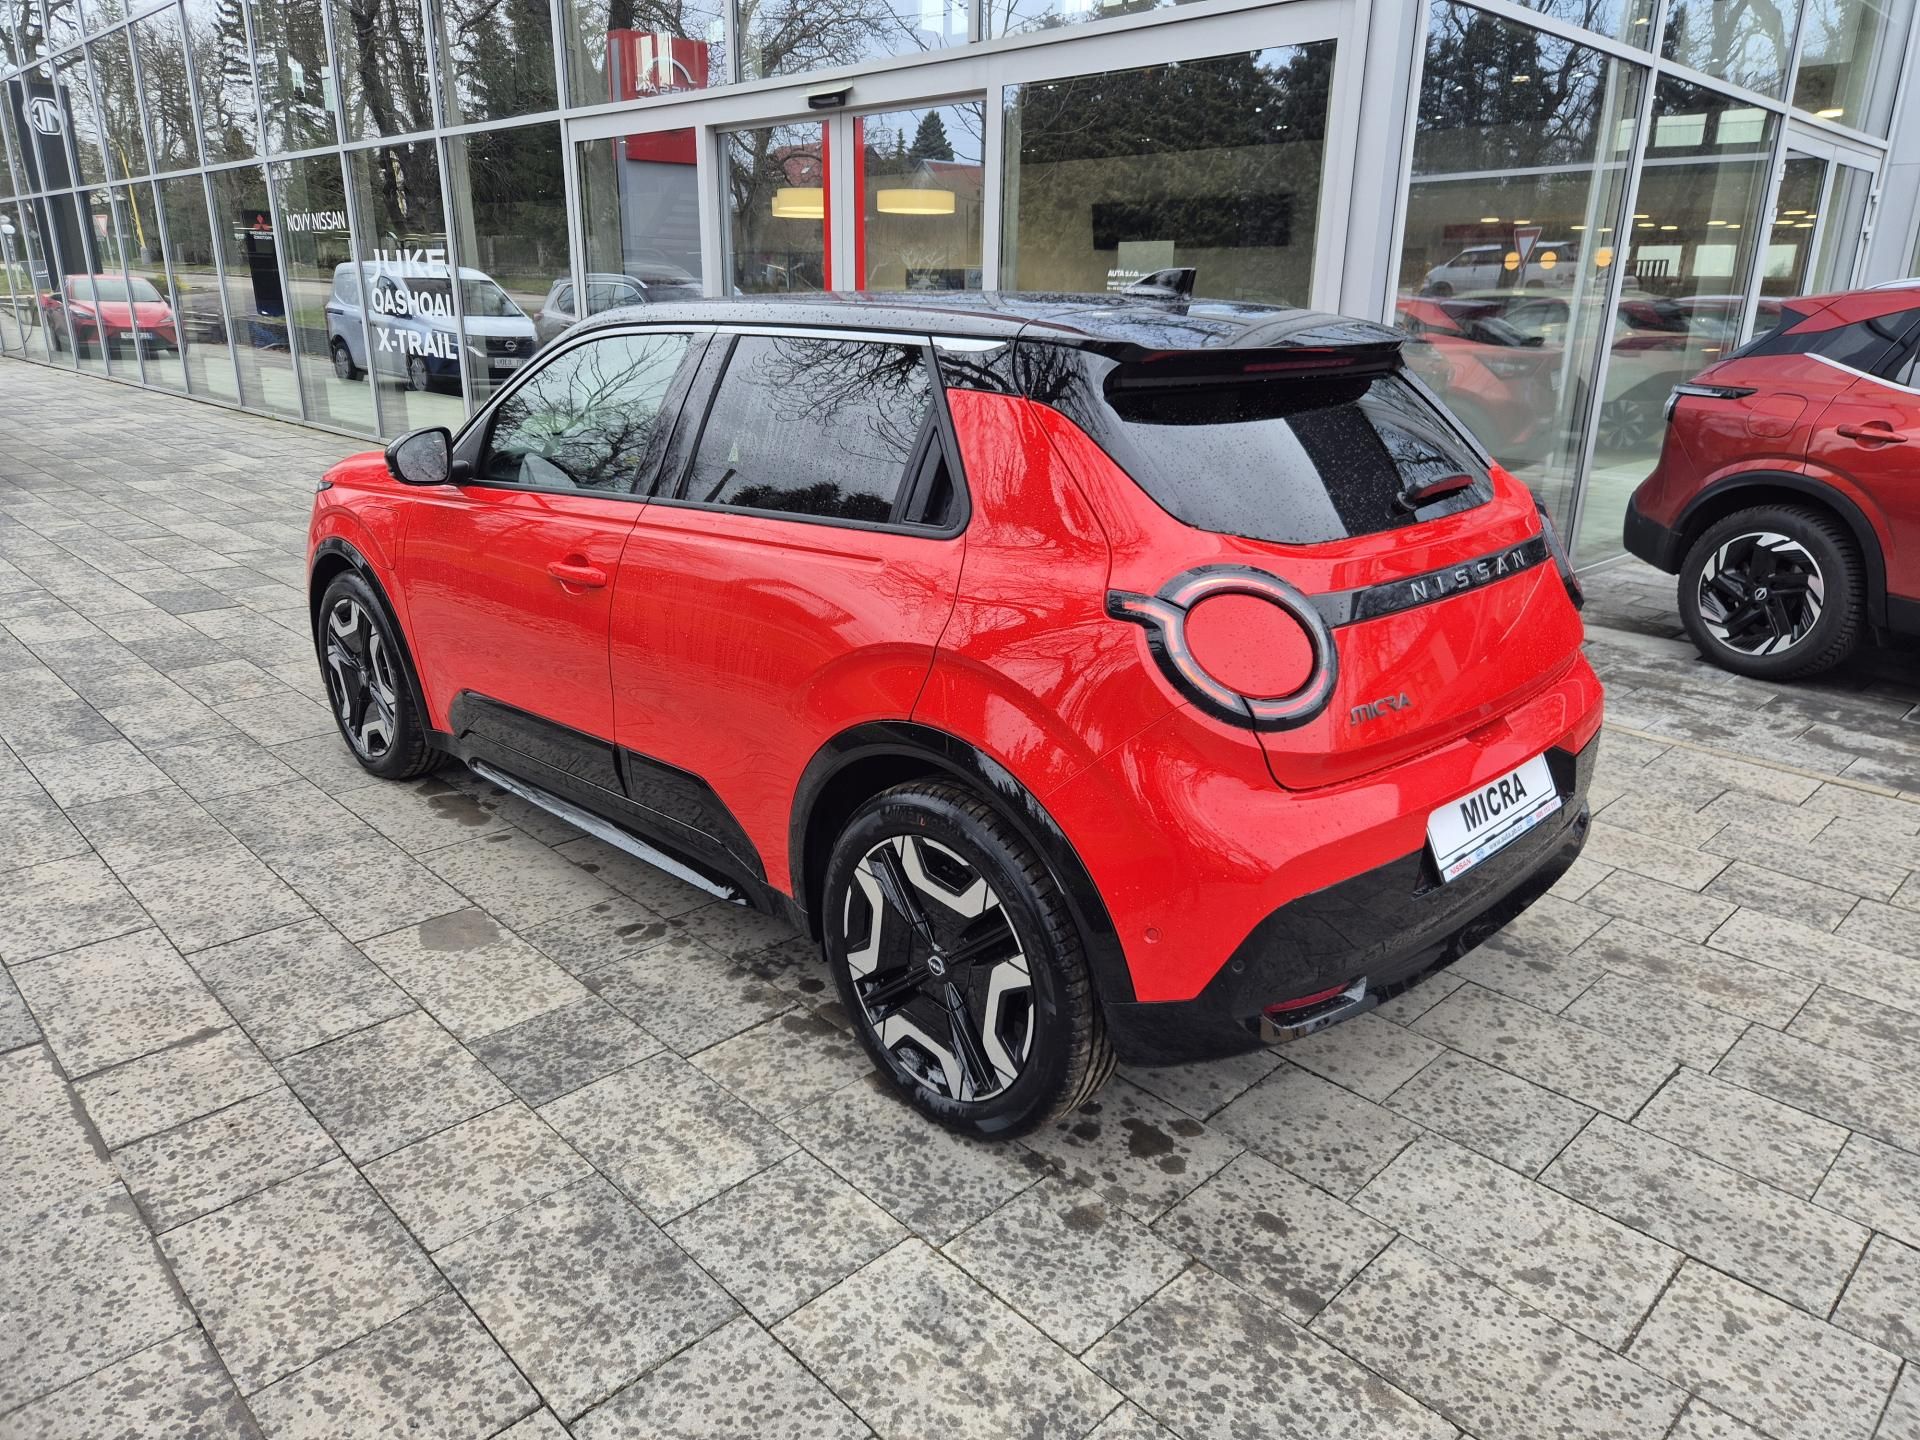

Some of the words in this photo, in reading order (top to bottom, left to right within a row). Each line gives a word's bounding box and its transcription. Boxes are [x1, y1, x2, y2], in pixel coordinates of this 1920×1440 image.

[286, 207, 311, 232] NOVÝ
[311, 210, 346, 231] NISSAN
[369, 248, 449, 283] JUKE
[1107, 269, 1124, 277] AUTA
[376, 327, 458, 360] X-TRAIL
[1410, 549, 1526, 602] NISSAN
[1350, 691, 1412, 726] MICRA
[1460, 772, 1528, 832] MICRA
[1449, 857, 1472, 875] NISSAN
